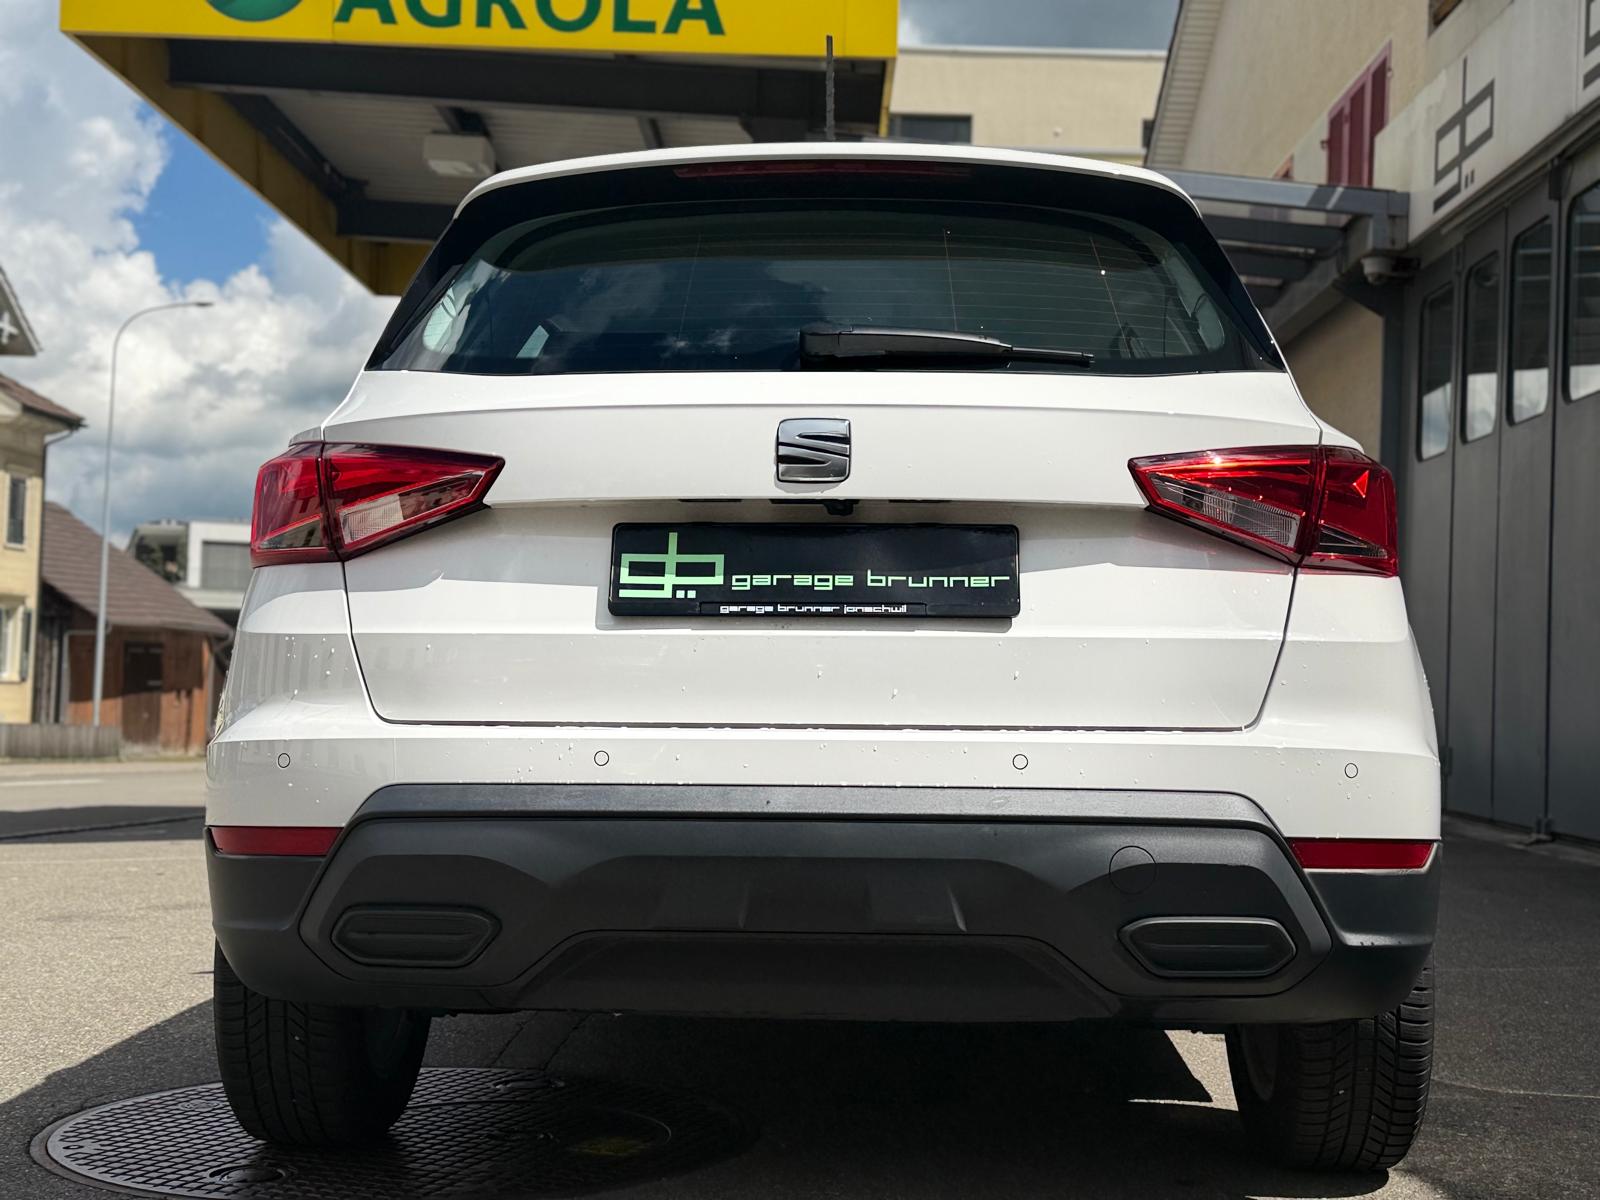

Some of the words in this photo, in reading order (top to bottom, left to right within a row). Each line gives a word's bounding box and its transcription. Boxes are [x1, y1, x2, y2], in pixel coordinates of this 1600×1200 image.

[732, 575, 853, 590] garage
[867, 570, 1009, 587] brunner
[778, 604, 840, 612] brunner
